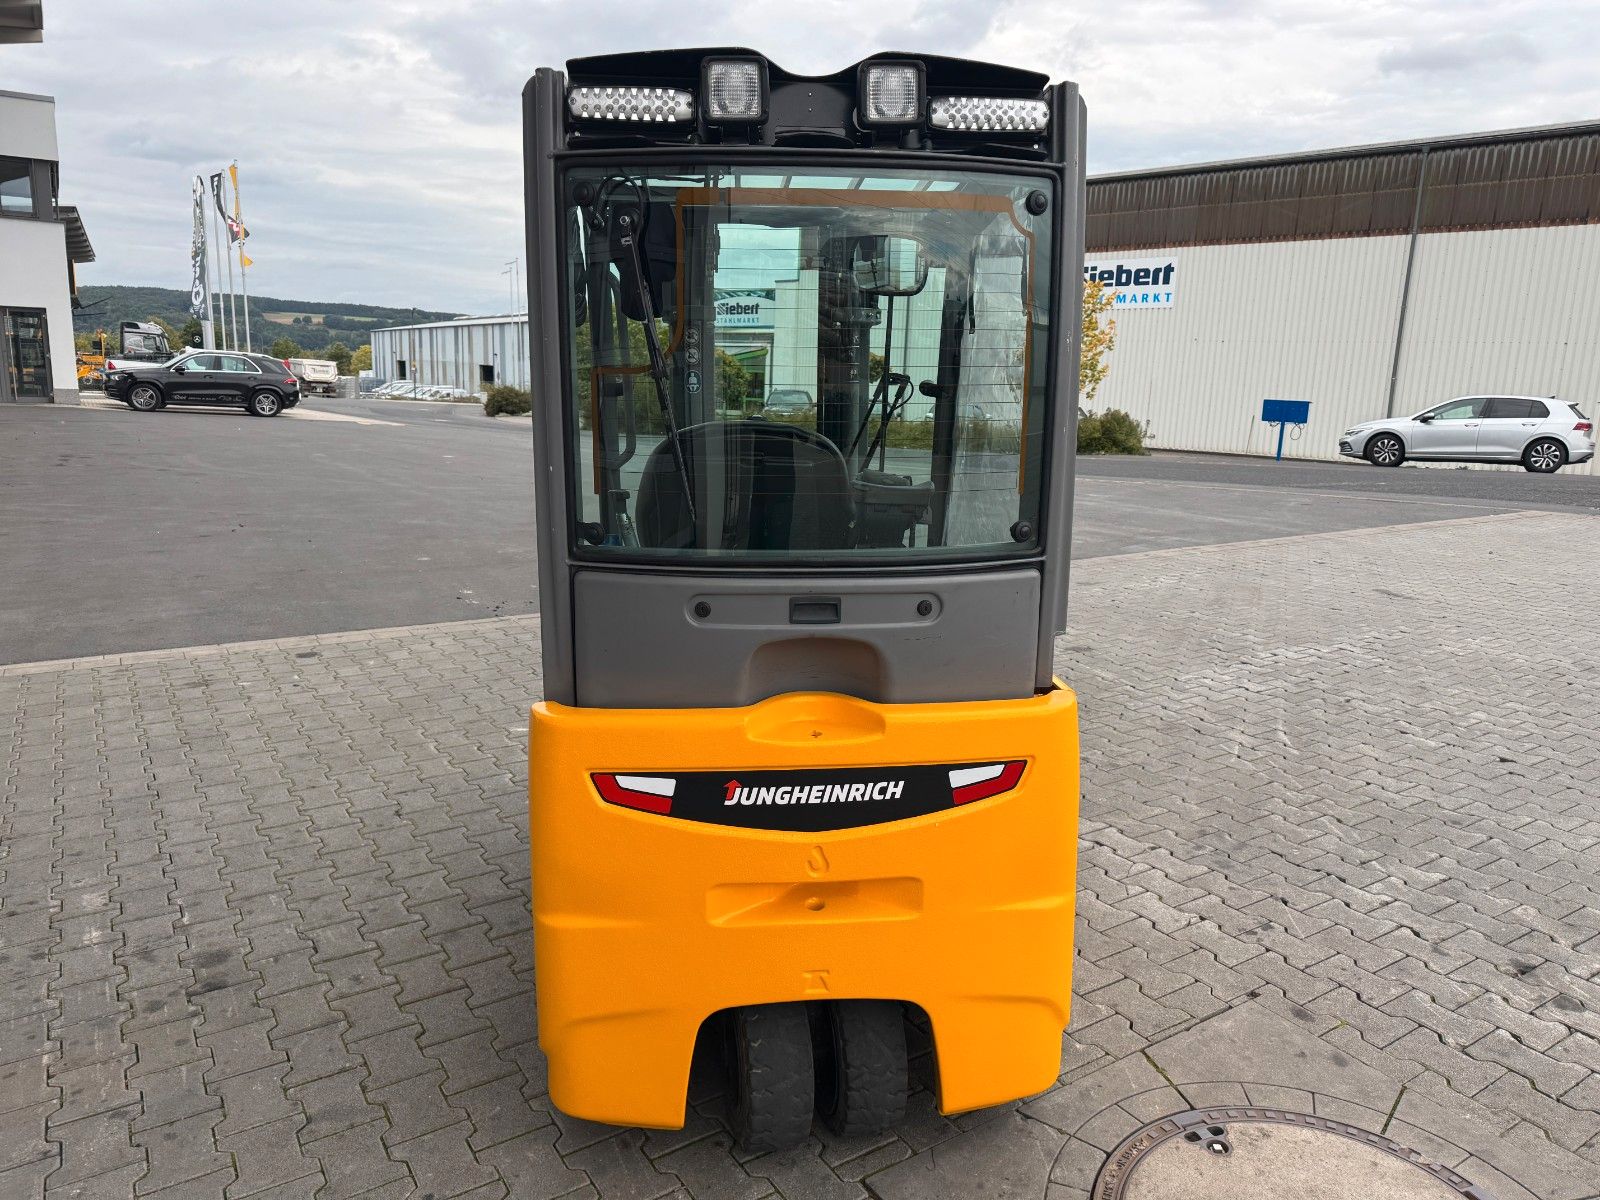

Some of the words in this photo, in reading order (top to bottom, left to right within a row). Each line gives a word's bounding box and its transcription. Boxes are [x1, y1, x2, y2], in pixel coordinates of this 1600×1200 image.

[1098, 293, 1172, 304] MARKT
[716, 303, 759, 315] Siebert
[723, 779, 906, 806] JUNGHEINRICH
